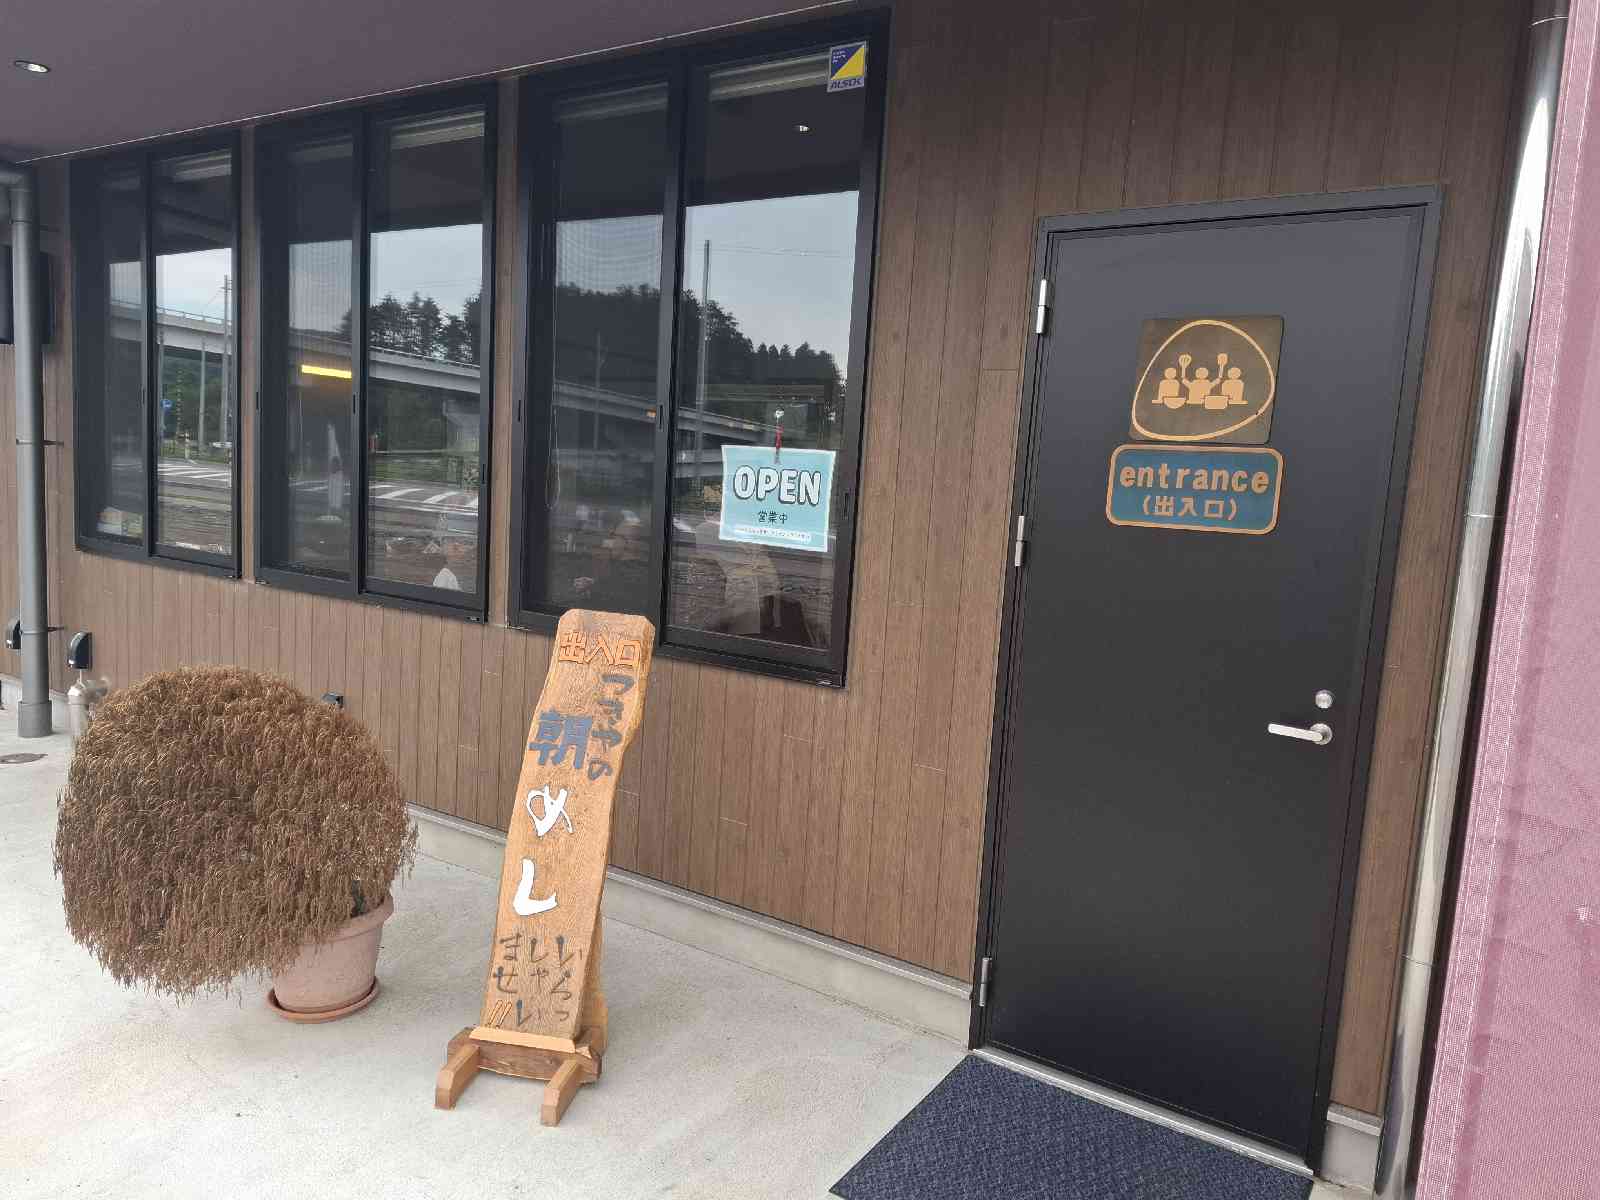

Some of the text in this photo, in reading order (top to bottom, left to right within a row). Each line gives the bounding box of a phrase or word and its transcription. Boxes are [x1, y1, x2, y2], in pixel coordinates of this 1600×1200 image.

[733, 465, 821, 506] OPEN
[1119, 463, 1270, 494] entrance
[758, 510, 787, 524] 営業中
[558, 631, 641, 667] 出入口
